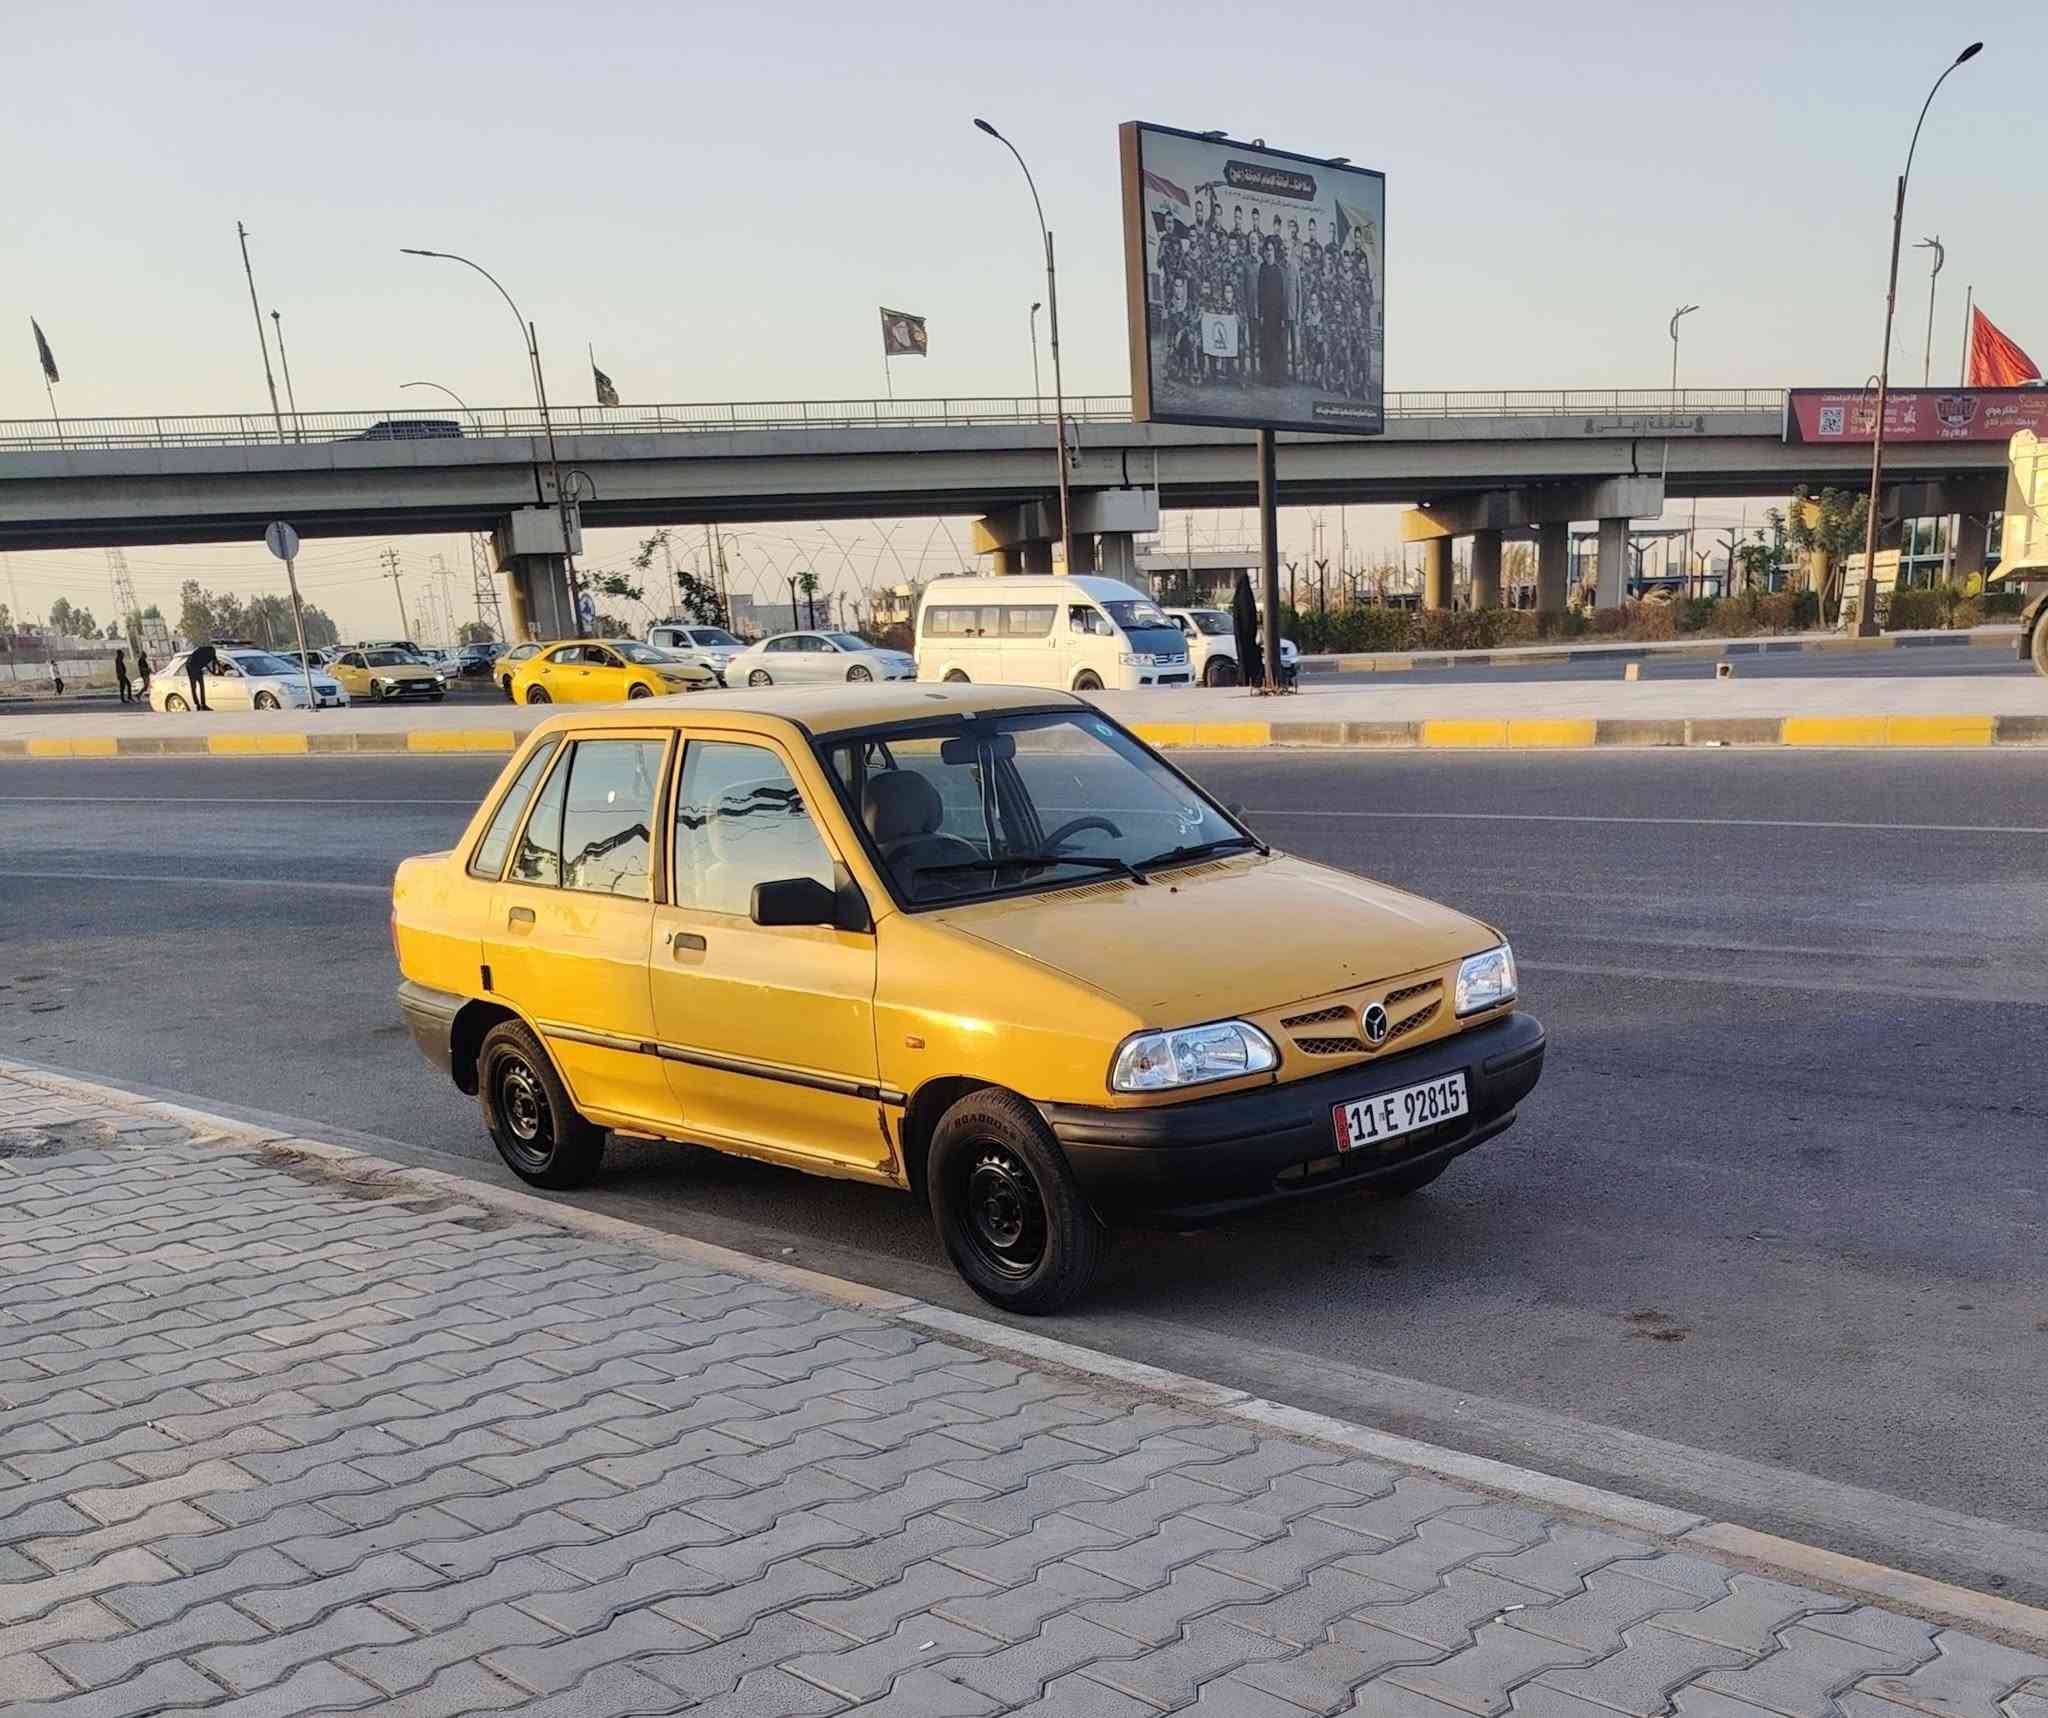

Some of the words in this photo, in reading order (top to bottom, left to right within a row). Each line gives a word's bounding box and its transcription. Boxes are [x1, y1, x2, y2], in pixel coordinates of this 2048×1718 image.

[1351, 1104, 1378, 1141] 11
[1384, 1098, 1398, 1132] E
[1404, 1080, 1460, 1126] 92815
